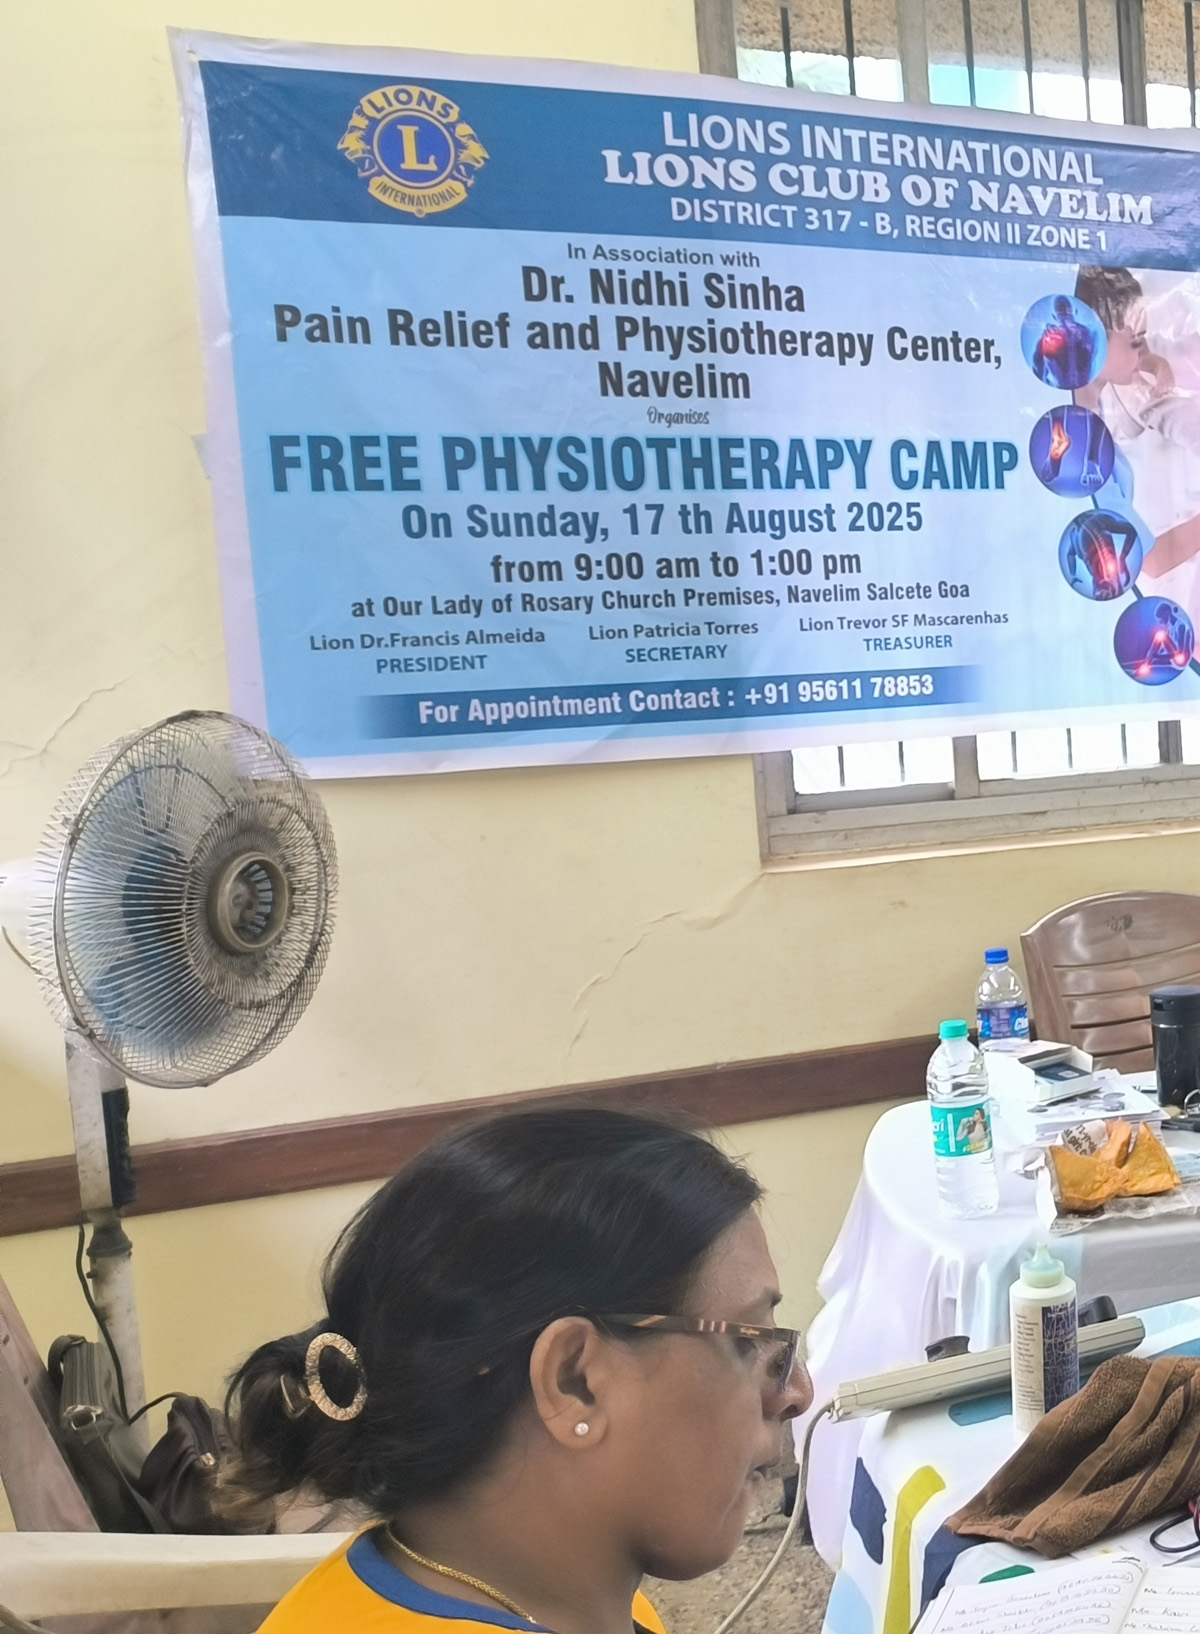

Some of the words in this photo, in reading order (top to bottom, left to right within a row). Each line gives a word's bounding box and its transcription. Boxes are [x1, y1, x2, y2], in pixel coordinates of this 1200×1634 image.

[366, 88, 454, 119] LIONS
[397, 124, 438, 172] L
[662, 111, 790, 154] LIONS
[801, 123, 1104, 185] INTERNATIONAL
[375, 181, 461, 208] INTERNATIONAL
[602, 149, 759, 193] LIONS
[767, 160, 891, 203] CLUB
[901, 173, 954, 208] OF
[970, 179, 1154, 226] NAVELIM
[671, 197, 798, 231] DISTRICT
[805, 208, 851, 233] 317
[875, 213, 898, 239] B,
[906, 214, 1000, 243] REGION
[1006, 219, 1021, 244] II
[1027, 224, 1090, 249] ZONE
[1096, 228, 1108, 250] 1
[567, 243, 587, 261] In
[592, 243, 714, 265] Association
[719, 249, 760, 267] with
[522, 266, 574, 304] Dr.
[590, 268, 689, 307] Nidhi
[704, 273, 804, 312] Sinha
[273, 303, 371, 344] Pain
[387, 308, 510, 350] Relief
[526, 315, 600, 351] and
[616, 316, 874, 366] Physiotherapy
[886, 327, 1002, 369] Center,
[598, 361, 751, 400] Navelim
[647, 406, 710, 428] Organises
[269, 434, 422, 494] FREE
[441, 435, 873, 493] PHYSIOTHERAPY
[890, 439, 1019, 492] CAMP
[402, 503, 452, 540] On
[467, 503, 609, 544] Sunday,
[622, 503, 665, 536] 17
[679, 502, 713, 535] th
[725, 501, 836, 540] August
[847, 501, 923, 533] 2025
[490, 554, 563, 584] from
[574, 552, 644, 582] 9:00
[655, 556, 700, 579] am
[710, 551, 739, 578] to
[750, 548, 812, 577] 1:00
[823, 552, 862, 580] pm
[351, 597, 375, 619] at
[383, 596, 423, 617] Our
[431, 594, 483, 620] Lady
[491, 593, 513, 615] of
[521, 592, 594, 615] Rosary
[602, 588, 676, 611] Church
[684, 586, 781, 609] Premises,
[787, 583, 860, 604] Navelim
[867, 581, 932, 602] Salcete
[938, 581, 970, 600] Goa
[310, 634, 354, 652] Lion
[360, 630, 460, 650] Dr.Francis
[465, 627, 546, 646] Almeida
[589, 624, 628, 641] Lion
[633, 621, 701, 640] Patricia
[704, 619, 759, 636] Torres
[799, 616, 834, 633] Lion
[837, 614, 888, 631] Trevor
[891, 613, 910, 630] SF
[913, 610, 1010, 629] Mascarenhas
[625, 644, 728, 664] SECRETARY
[863, 634, 953, 652] TREASURER
[376, 654, 488, 674] PRESIDENT
[419, 700, 459, 725] For
[468, 690, 622, 726] Appointment
[629, 686, 721, 713] Contact
[744, 682, 790, 706] +91
[798, 677, 863, 703] 95611
[870, 674, 934, 698] 78853
